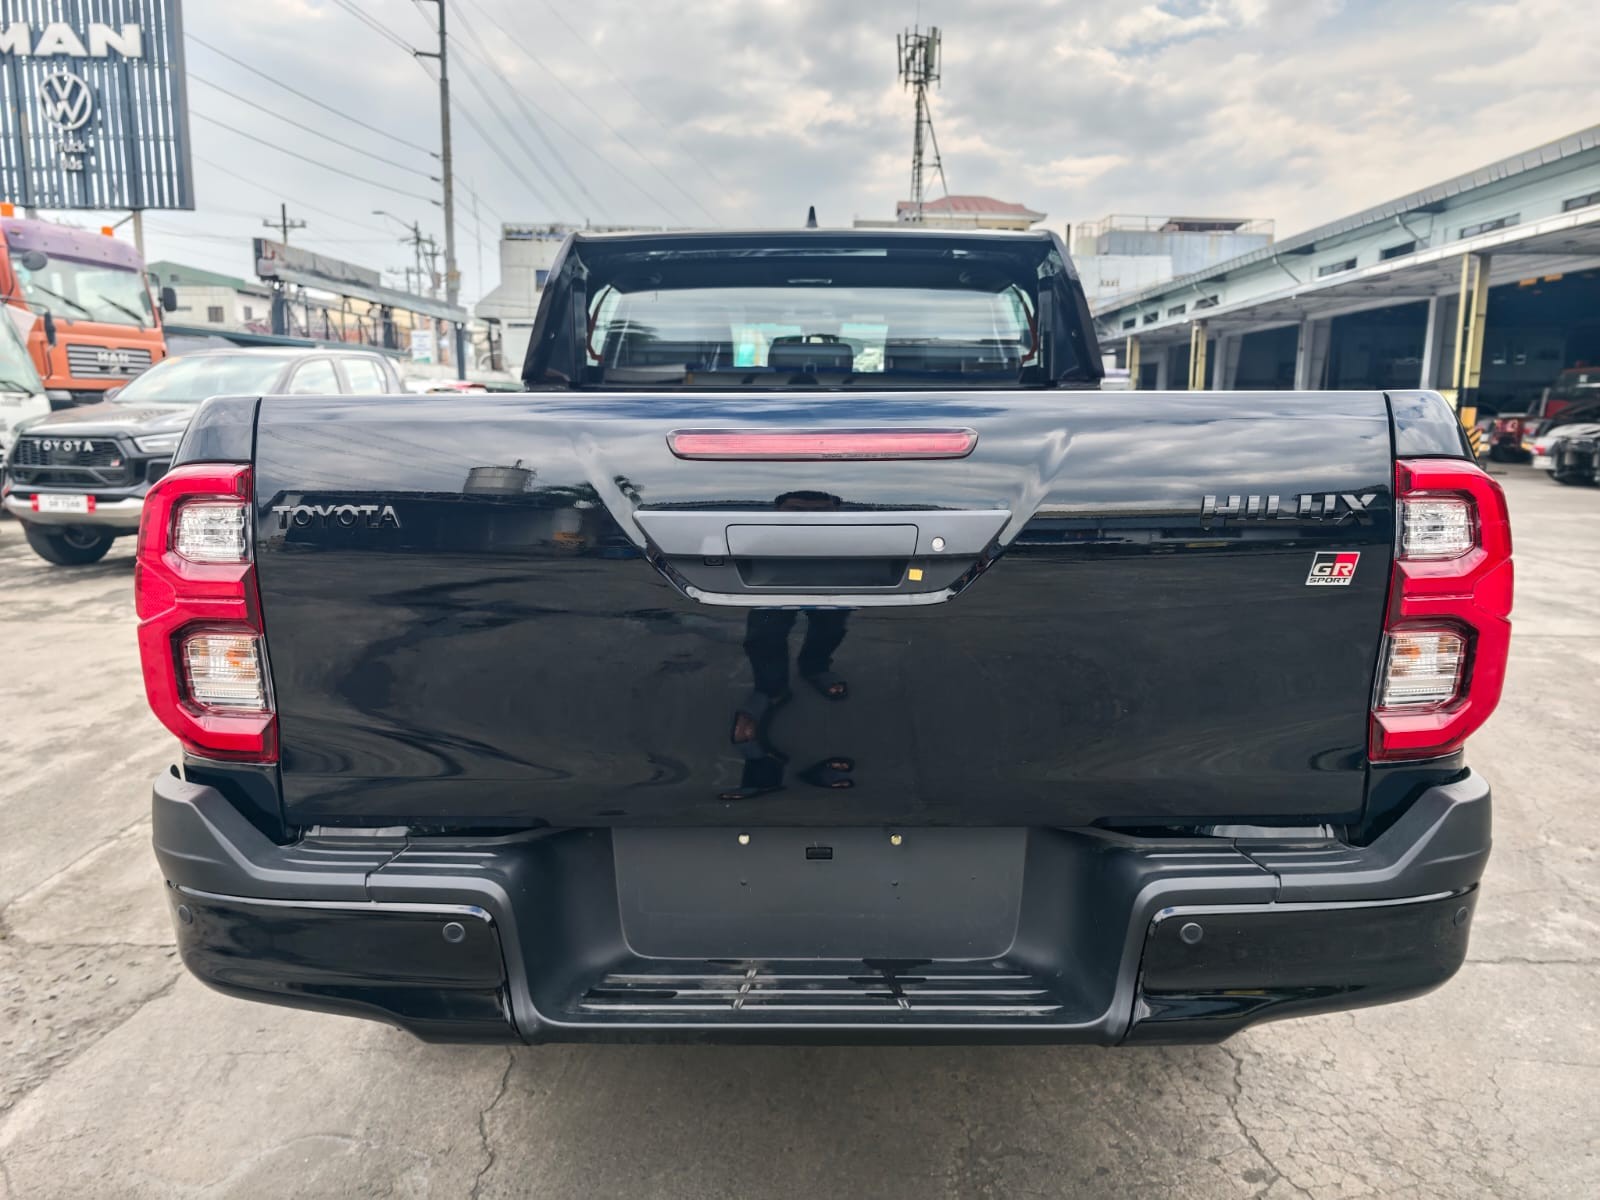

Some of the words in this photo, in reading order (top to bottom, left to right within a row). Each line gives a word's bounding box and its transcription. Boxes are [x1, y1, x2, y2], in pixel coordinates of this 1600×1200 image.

[0, 22, 143, 58] MAN
[33, 440, 94, 452] TOYOTA
[271, 504, 400, 529] TOYOTA
[1202, 494, 1377, 528] HILUX
[1312, 562, 1354, 576] GR
